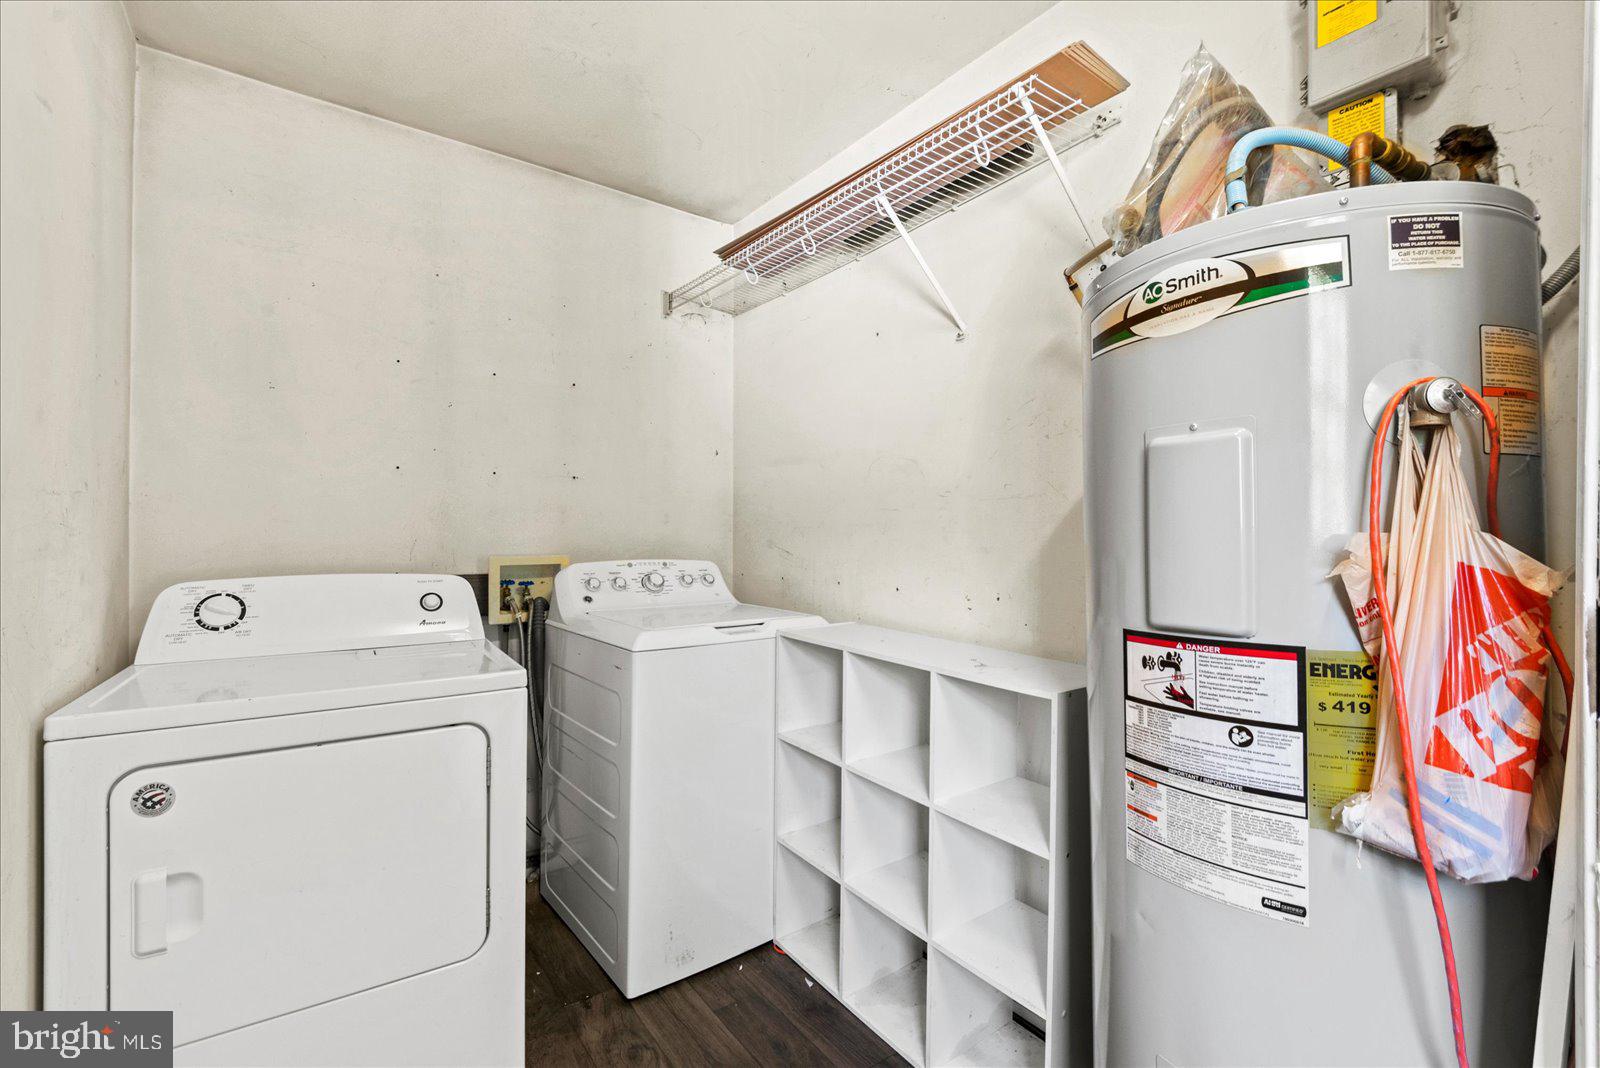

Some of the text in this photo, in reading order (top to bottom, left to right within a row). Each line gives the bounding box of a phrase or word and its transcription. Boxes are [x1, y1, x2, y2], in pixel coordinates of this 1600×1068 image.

[1339, 98, 1373, 115] CAUTION
[1186, 643, 1220, 653] DANGER
[1310, 662, 1377, 680] ENERG
[1332, 700, 1371, 714] 419
[1168, 768, 1200, 781] IMPORTANT
[1202, 777, 1243, 791] IMPORTANTE
[133, 783, 170, 801] AMERICA
